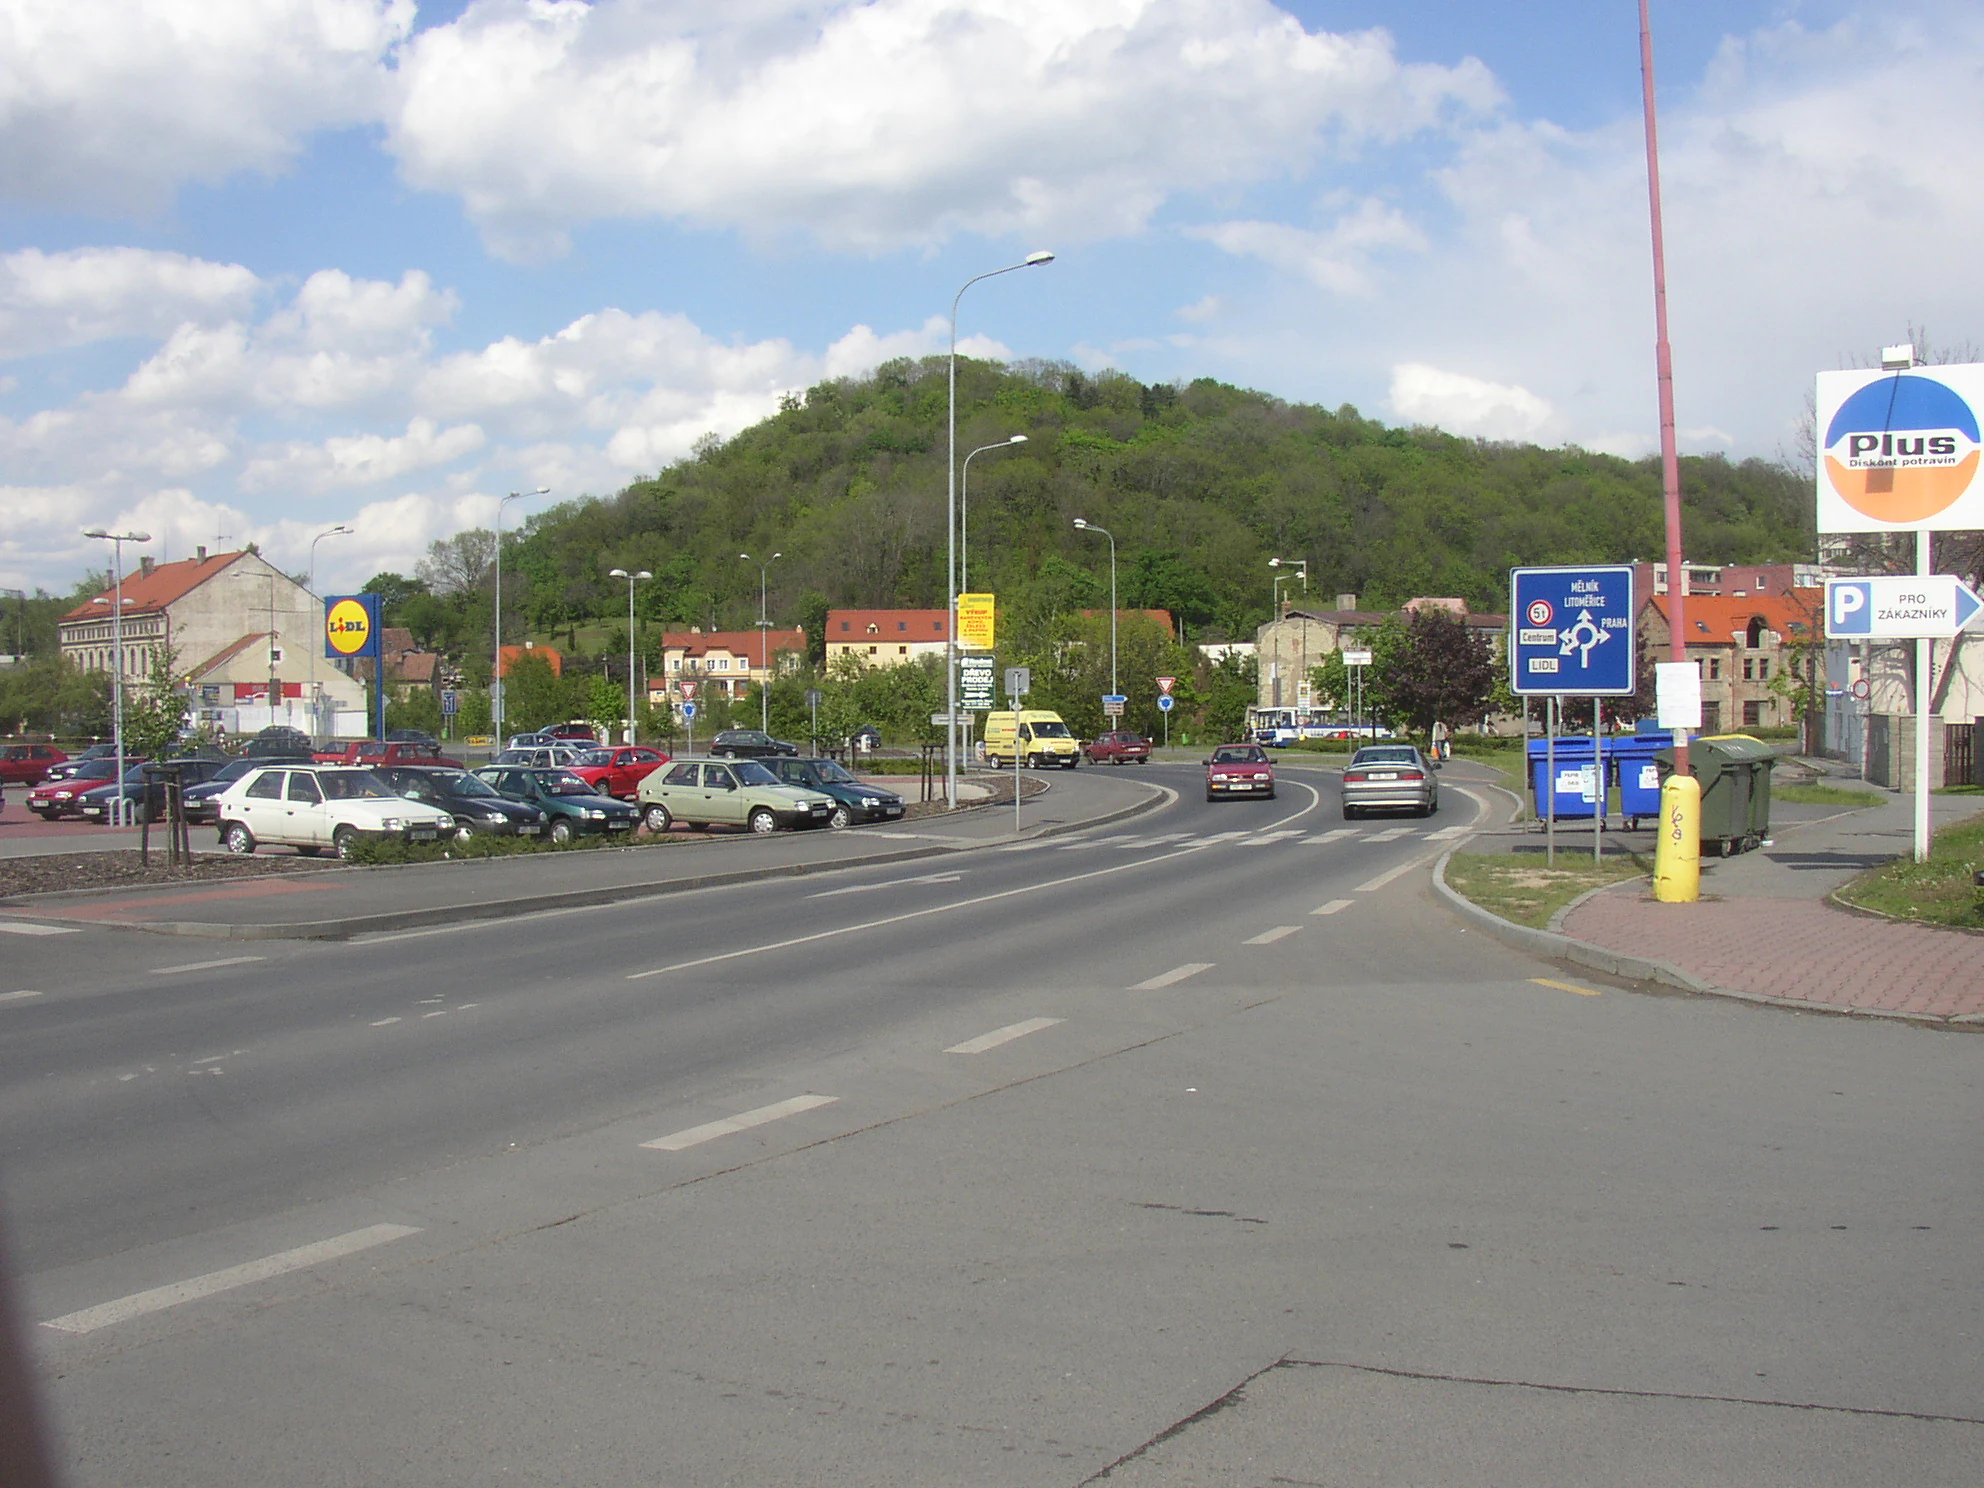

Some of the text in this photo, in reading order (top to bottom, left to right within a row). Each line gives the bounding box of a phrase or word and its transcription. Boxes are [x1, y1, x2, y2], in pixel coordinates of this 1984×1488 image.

[1849, 433, 1956, 458] Plus
[1849, 456, 1956, 468] Diskont potravin
[1570, 579, 1600, 593] MĚLNÍK
[1563, 594, 1606, 608] LITOMĚŘICE
[1833, 586, 1865, 625] P
[1898, 594, 1927, 605] PRO
[1877, 606, 1948, 620] ZÁKAZNÍKY
[1601, 617, 1628, 629] PRAHA
[1522, 632, 1555, 643] Centrum
[1531, 660, 1557, 671] LIDL
